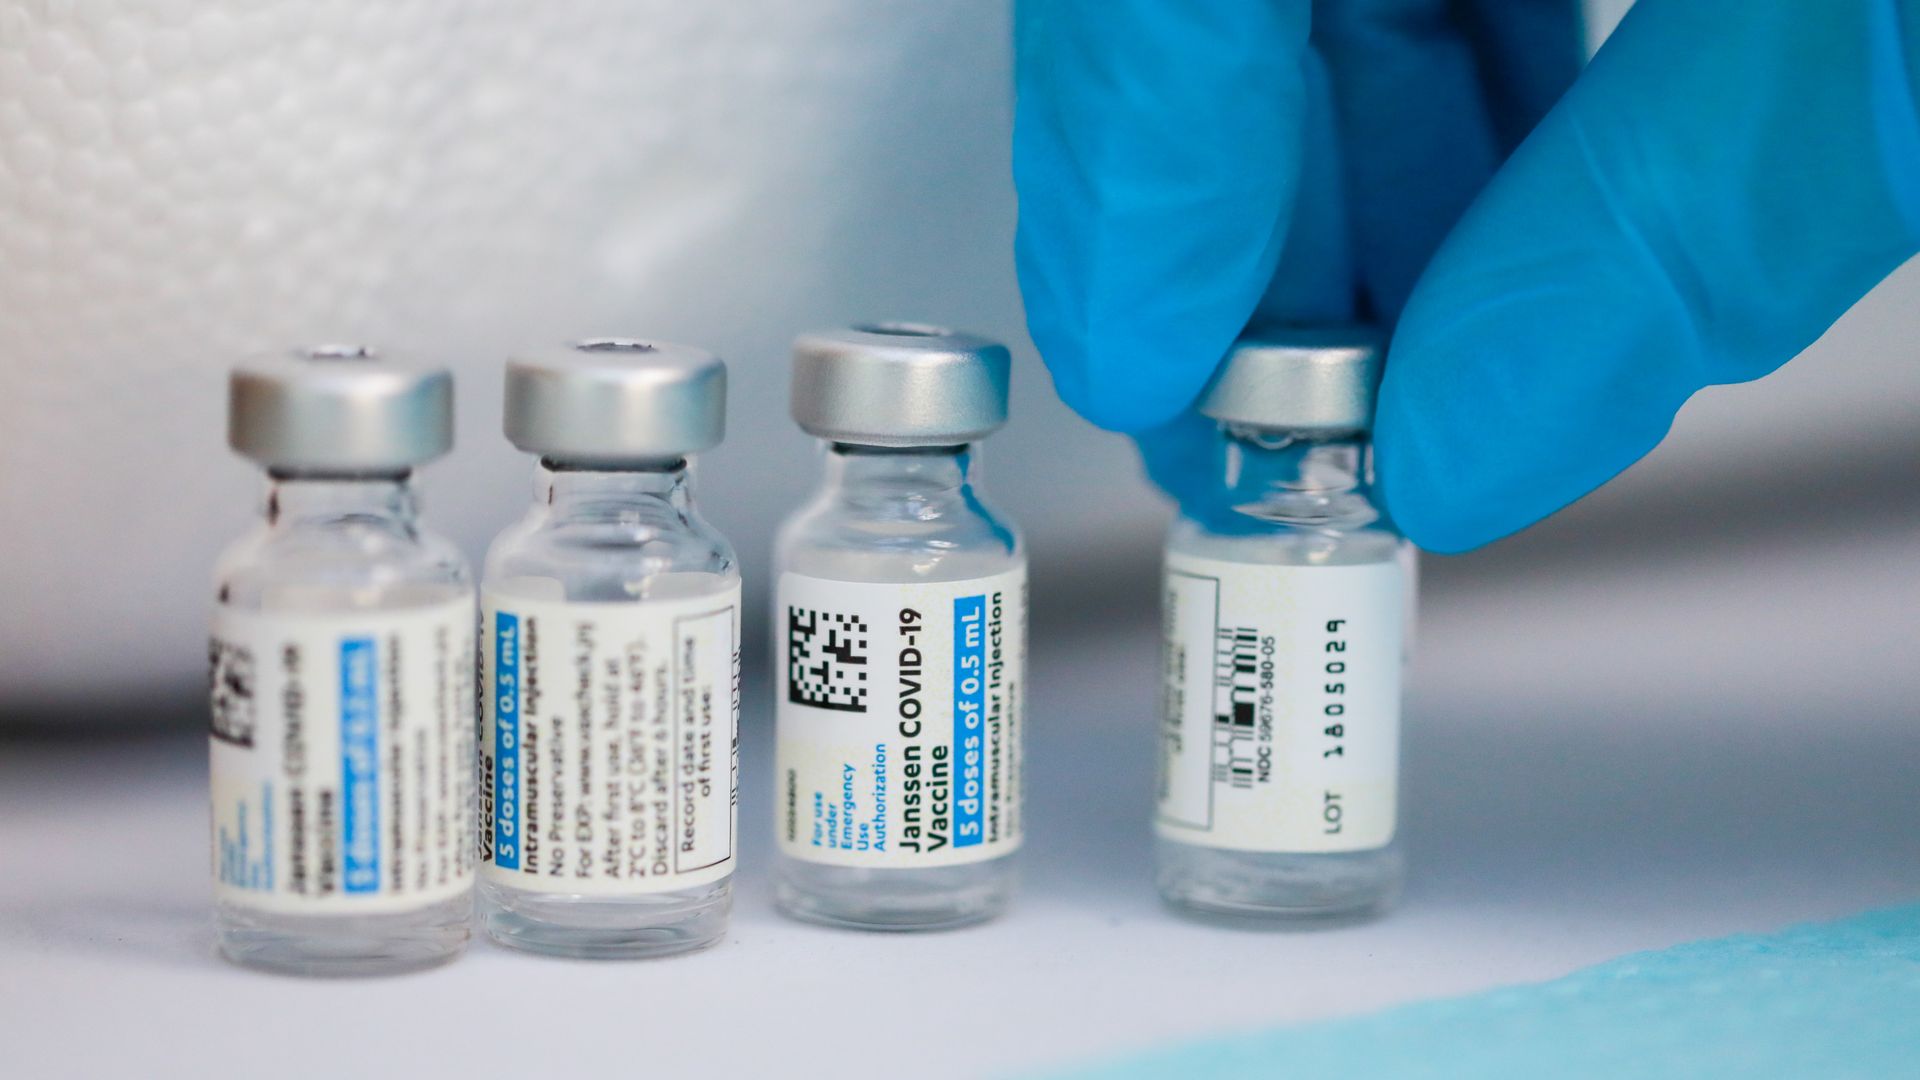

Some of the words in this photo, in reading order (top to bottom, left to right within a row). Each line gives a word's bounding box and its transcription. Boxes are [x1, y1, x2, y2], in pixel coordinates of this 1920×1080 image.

[500, 625, 515, 665] mL
[961, 606, 980, 647] mL
[988, 591, 1004, 689] Injection
[524, 616, 541, 715] Injection
[683, 637, 696, 683] time
[899, 607, 921, 738] COVID-19
[960, 655, 980, 695] 0.5
[500, 674, 514, 713] 0.5
[682, 686, 696, 726] and
[1259, 636, 1275, 740] 59676-580-05
[1324, 619, 1346, 758] 1805029
[498, 719, 514, 748] of
[958, 701, 979, 730] of
[652, 749, 668, 794] after
[682, 733, 696, 776] date
[698, 731, 711, 772] first
[987, 695, 1001, 843] Intramuscular
[1257, 747, 1271, 783] NDC
[498, 759, 514, 837] doses
[522, 723, 538, 874] Intramuscular
[549, 716, 564, 842] Preservative
[698, 778, 711, 798] of
[873, 743, 887, 852] Authorization
[958, 737, 979, 816] doses
[484, 756, 493, 862] Vaccine
[603, 782, 620, 821] first
[682, 782, 696, 853] Record
[812, 791, 823, 819] use
[841, 763, 856, 850] Emergency
[899, 745, 921, 853] Janssen
[926, 745, 948, 853] Vaccine
[1324, 791, 1342, 835] LOT
[631, 820, 646, 840] to
[653, 801, 668, 877] Discard
[811, 823, 823, 847] For
[826, 803, 838, 849] under
[857, 823, 869, 851] Use
[959, 820, 978, 837] 5
[500, 843, 514, 859] 5
[550, 846, 564, 877] No
[576, 848, 592, 878] For
[603, 828, 620, 878] After
